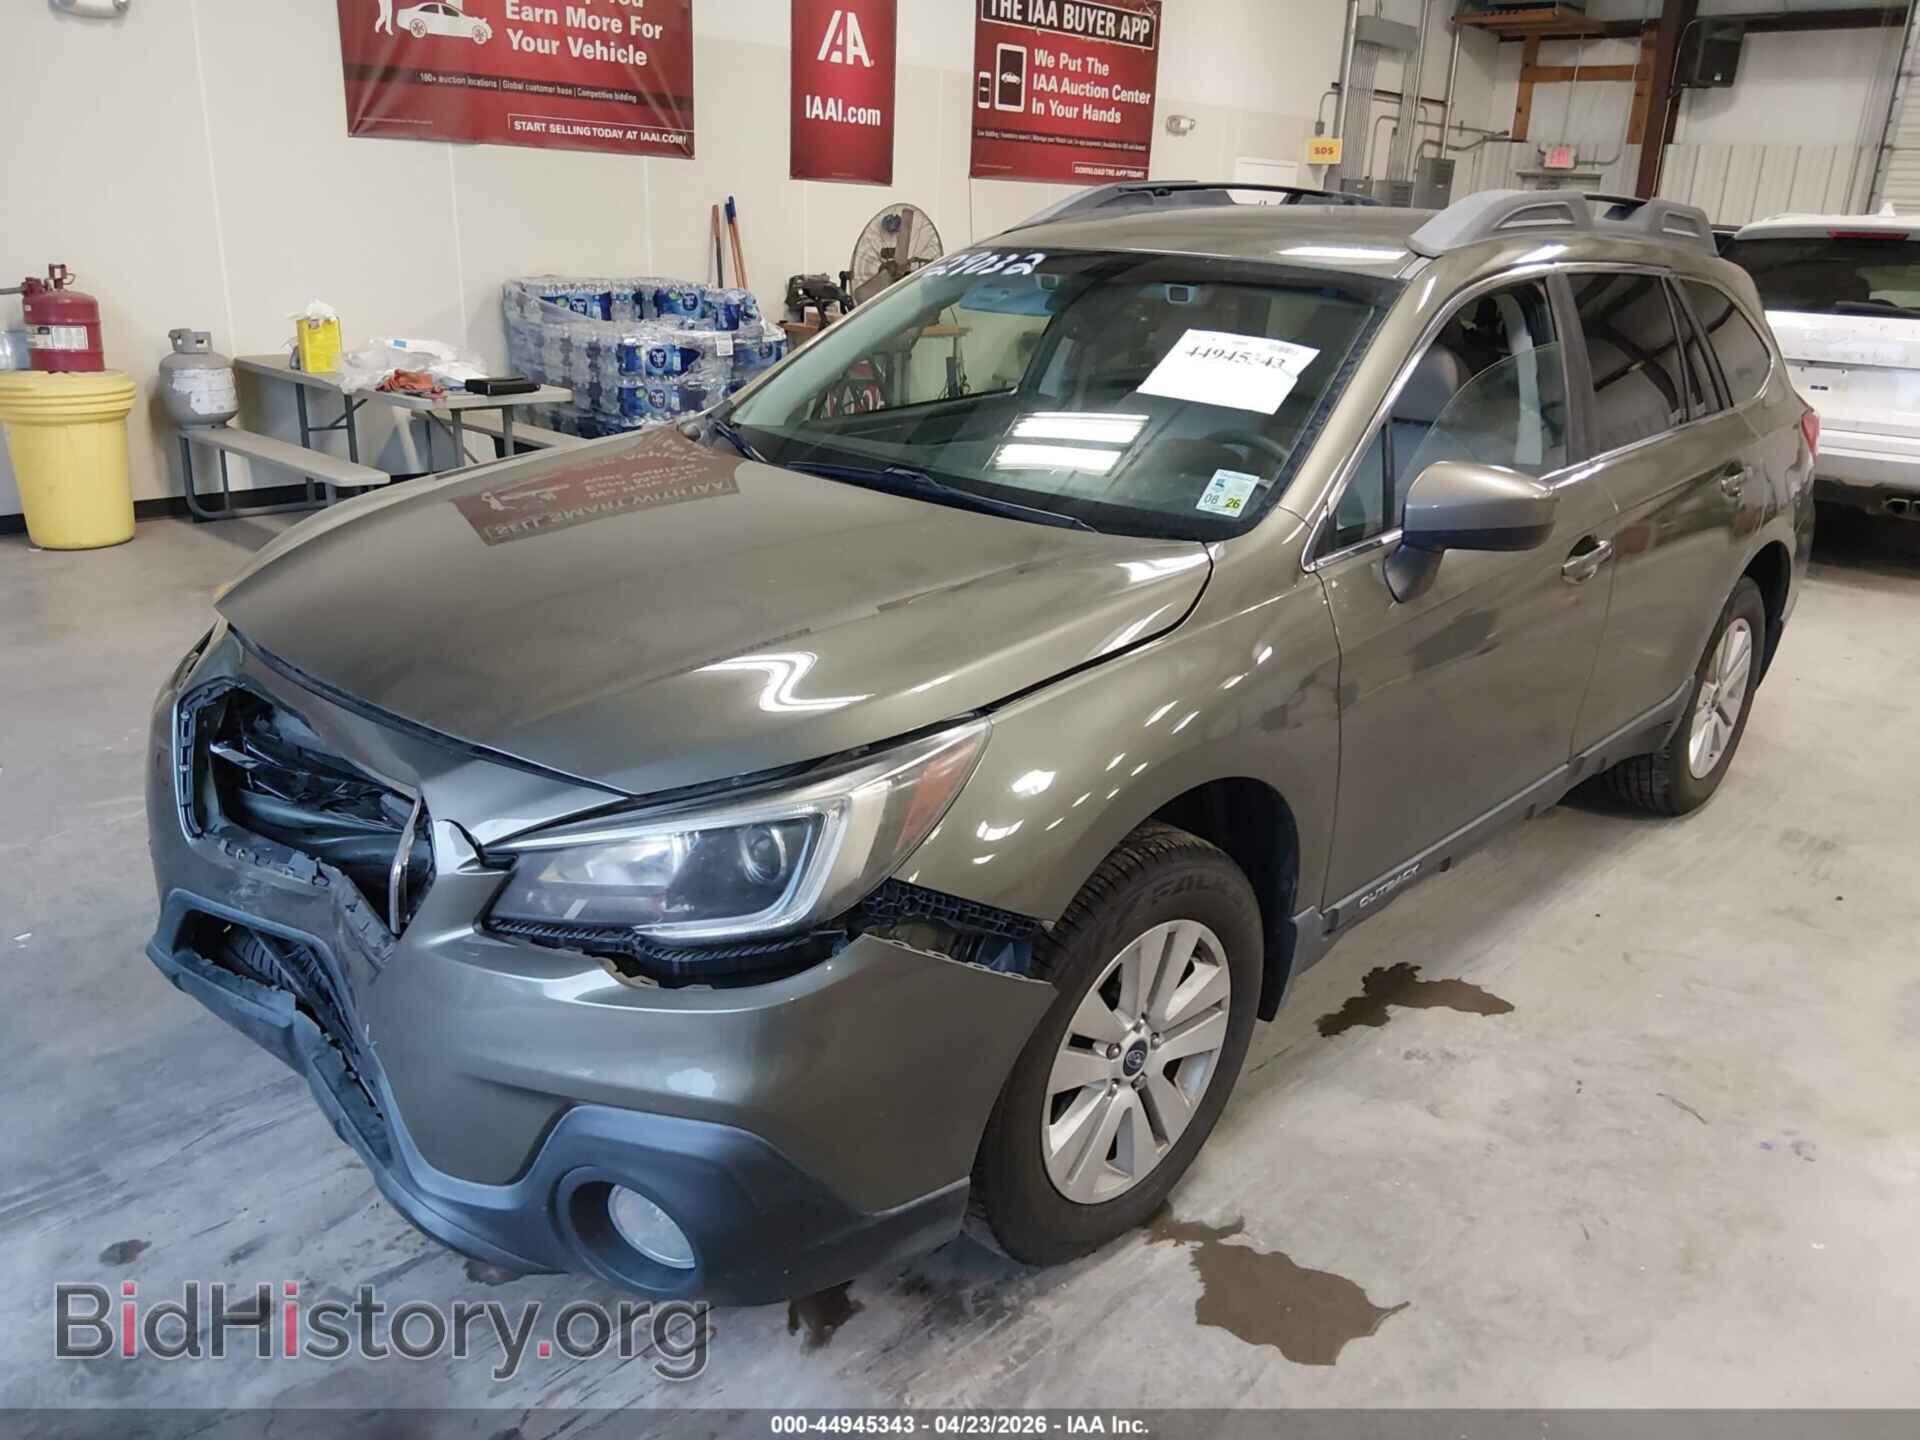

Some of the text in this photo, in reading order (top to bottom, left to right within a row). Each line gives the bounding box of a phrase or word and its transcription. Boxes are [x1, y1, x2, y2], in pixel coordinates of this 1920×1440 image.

[505, 0, 664, 39] Earn More For
[990, 0, 1150, 43] THE IAA BUYER APP
[506, 28, 648, 66] Your Vehicle
[1034, 48, 1110, 76] We Put The
[1033, 73, 1151, 105] IAA Auction Center
[805, 94, 881, 126] IAAI.com
[1032, 97, 1122, 124] In Your Hands
[513, 120, 546, 132] START
[549, 123, 591, 137] SELLING
[592, 127, 623, 140] TODAY
[626, 129, 638, 140] AT
[1225, 497, 1241, 509] 26
